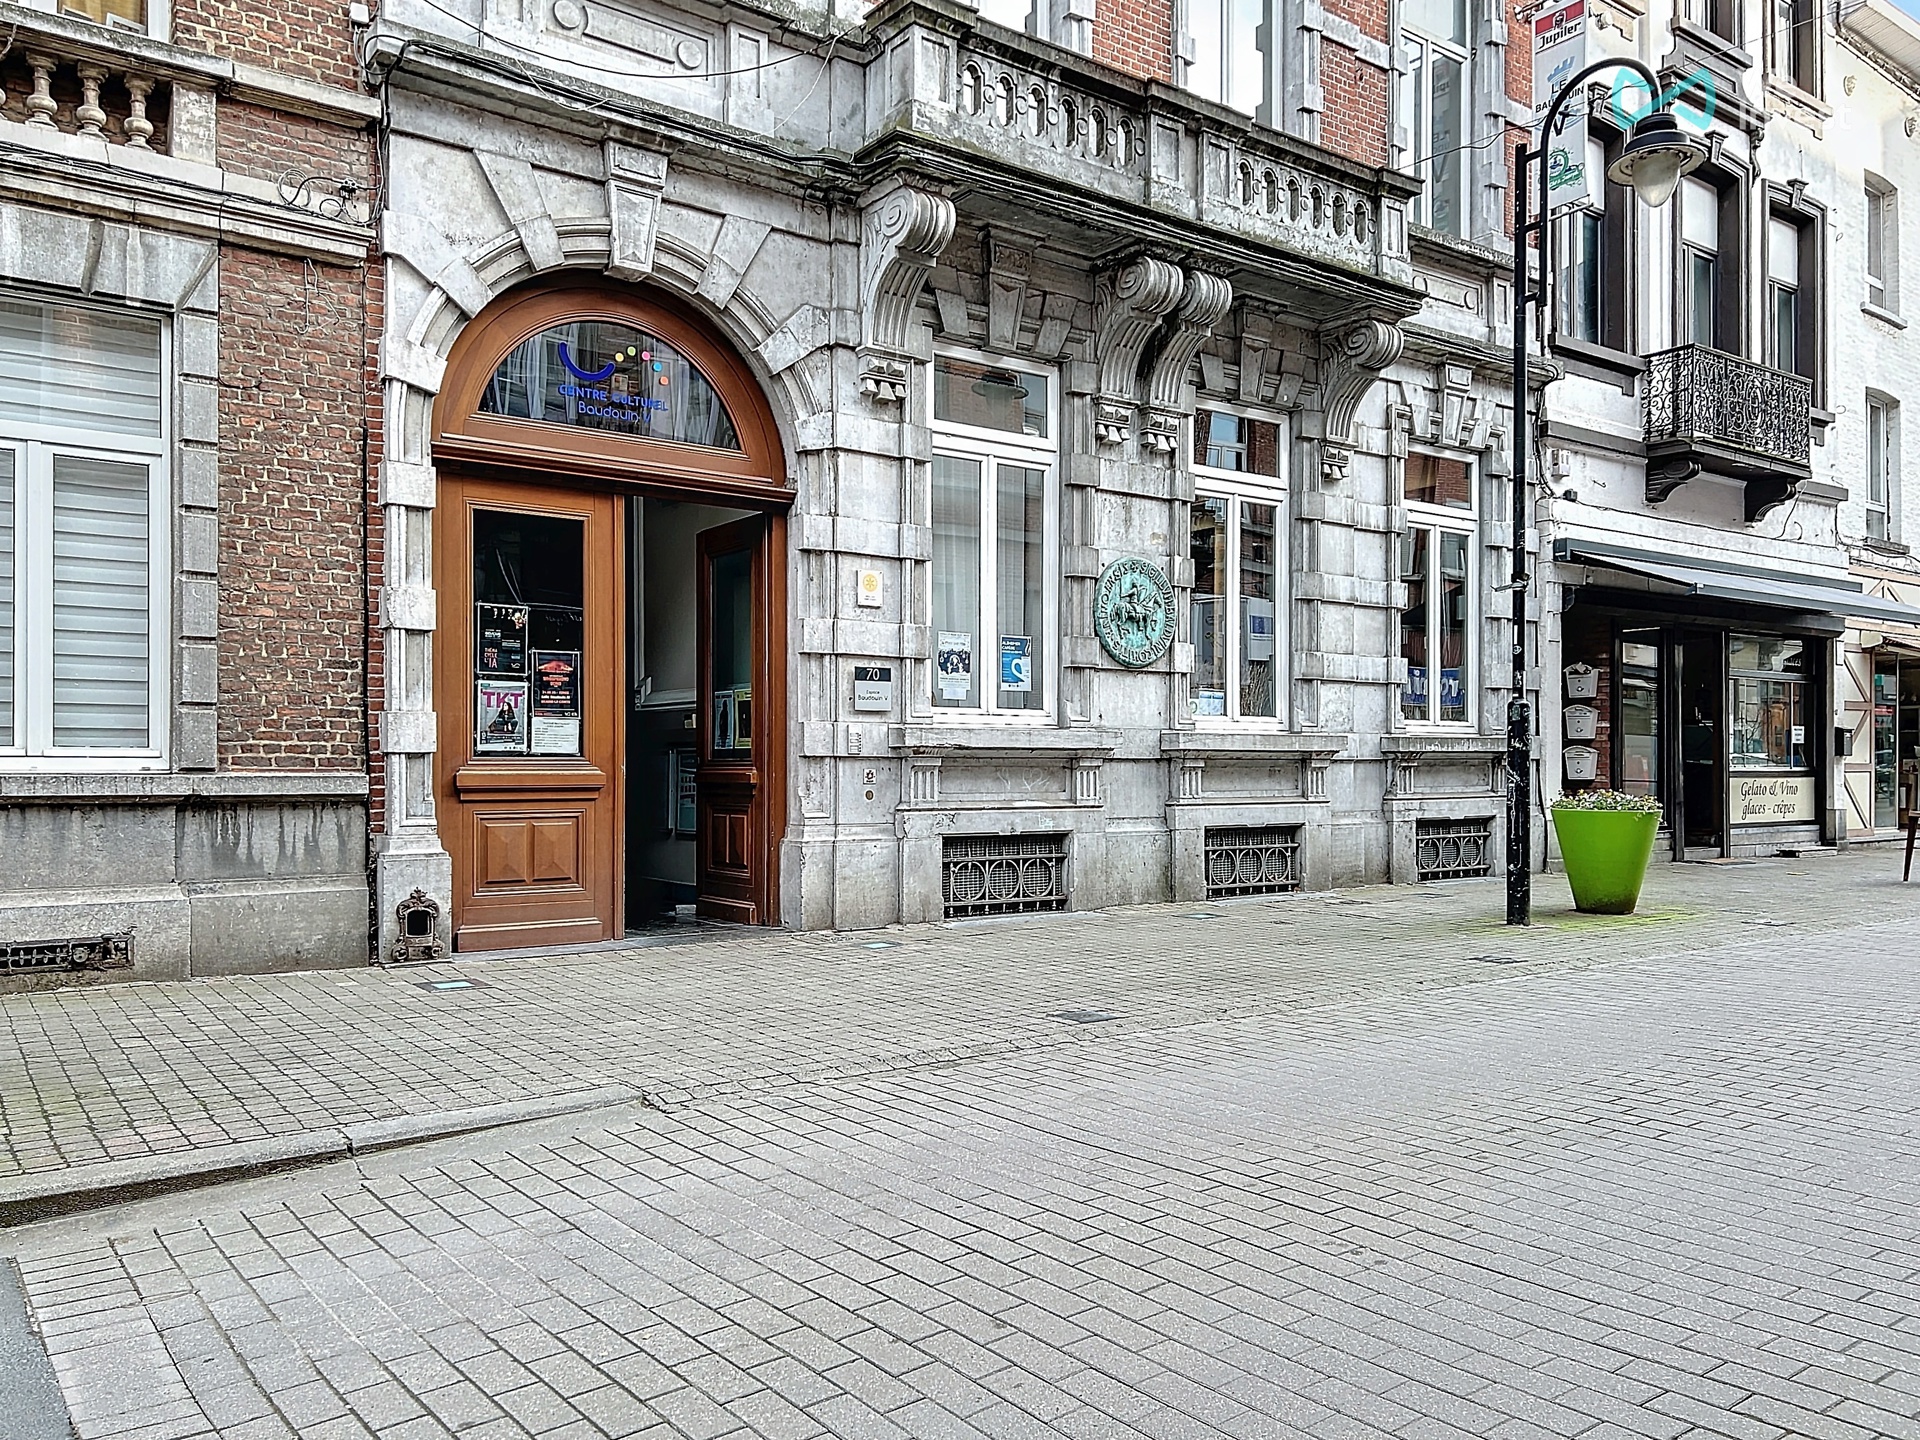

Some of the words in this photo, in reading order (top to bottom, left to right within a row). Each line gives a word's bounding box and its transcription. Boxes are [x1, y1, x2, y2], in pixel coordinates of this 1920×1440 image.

[1538, 22, 1582, 49] Jupiler
[1552, 79, 1567, 94] LE
[1535, 85, 1585, 113] BAUUIN
[558, 384, 608, 402] CENTRE
[611, 393, 669, 412] CULTUREL
[578, 401, 639, 422] Baudouin
[866, 668, 880, 681] 70
[482, 691, 523, 709] TKT
[1741, 780, 1767, 801] Gelato
[1769, 780, 1779, 796] &
[1780, 780, 1798, 796] Vino
[1741, 799, 1766, 820] glaces
[1773, 800, 1796, 819] crêpes
